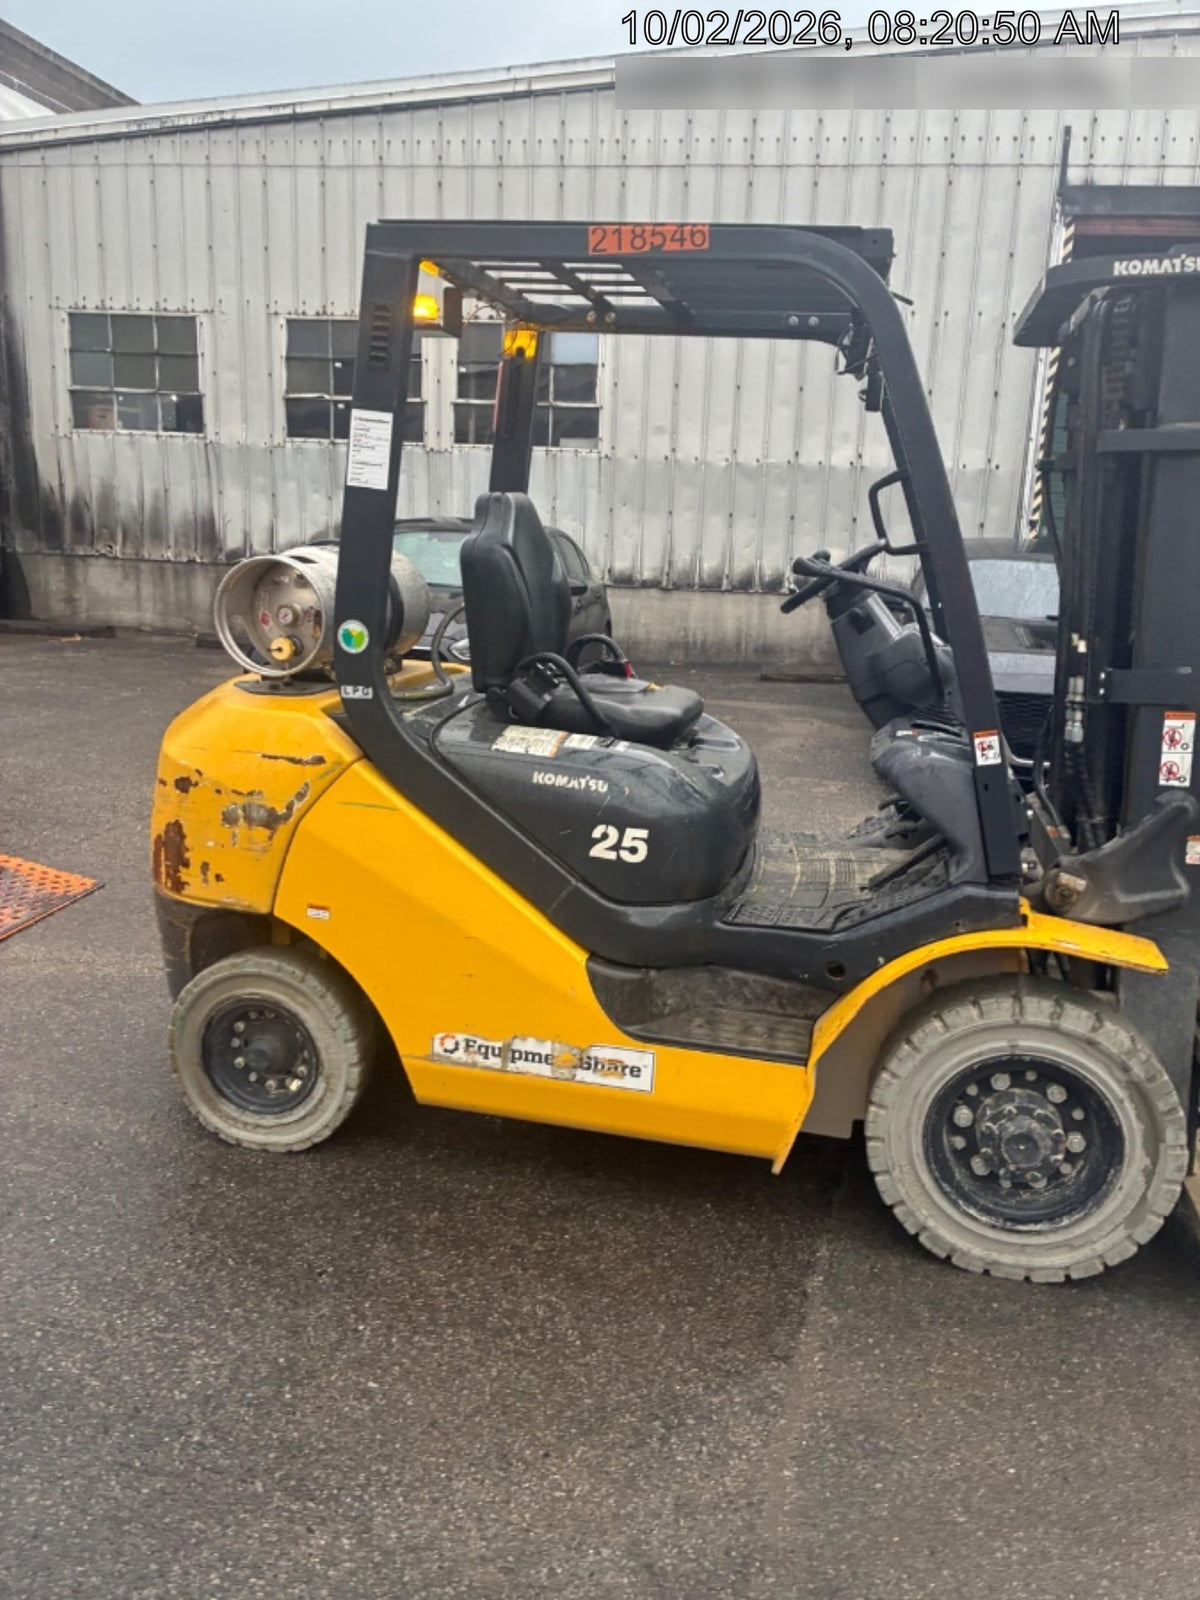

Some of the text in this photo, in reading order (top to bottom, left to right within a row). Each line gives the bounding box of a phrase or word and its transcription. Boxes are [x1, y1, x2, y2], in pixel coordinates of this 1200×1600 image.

[590, 223, 707, 253] 218546
[532, 770, 609, 793] KOMATSU
[588, 824, 649, 864] 25
